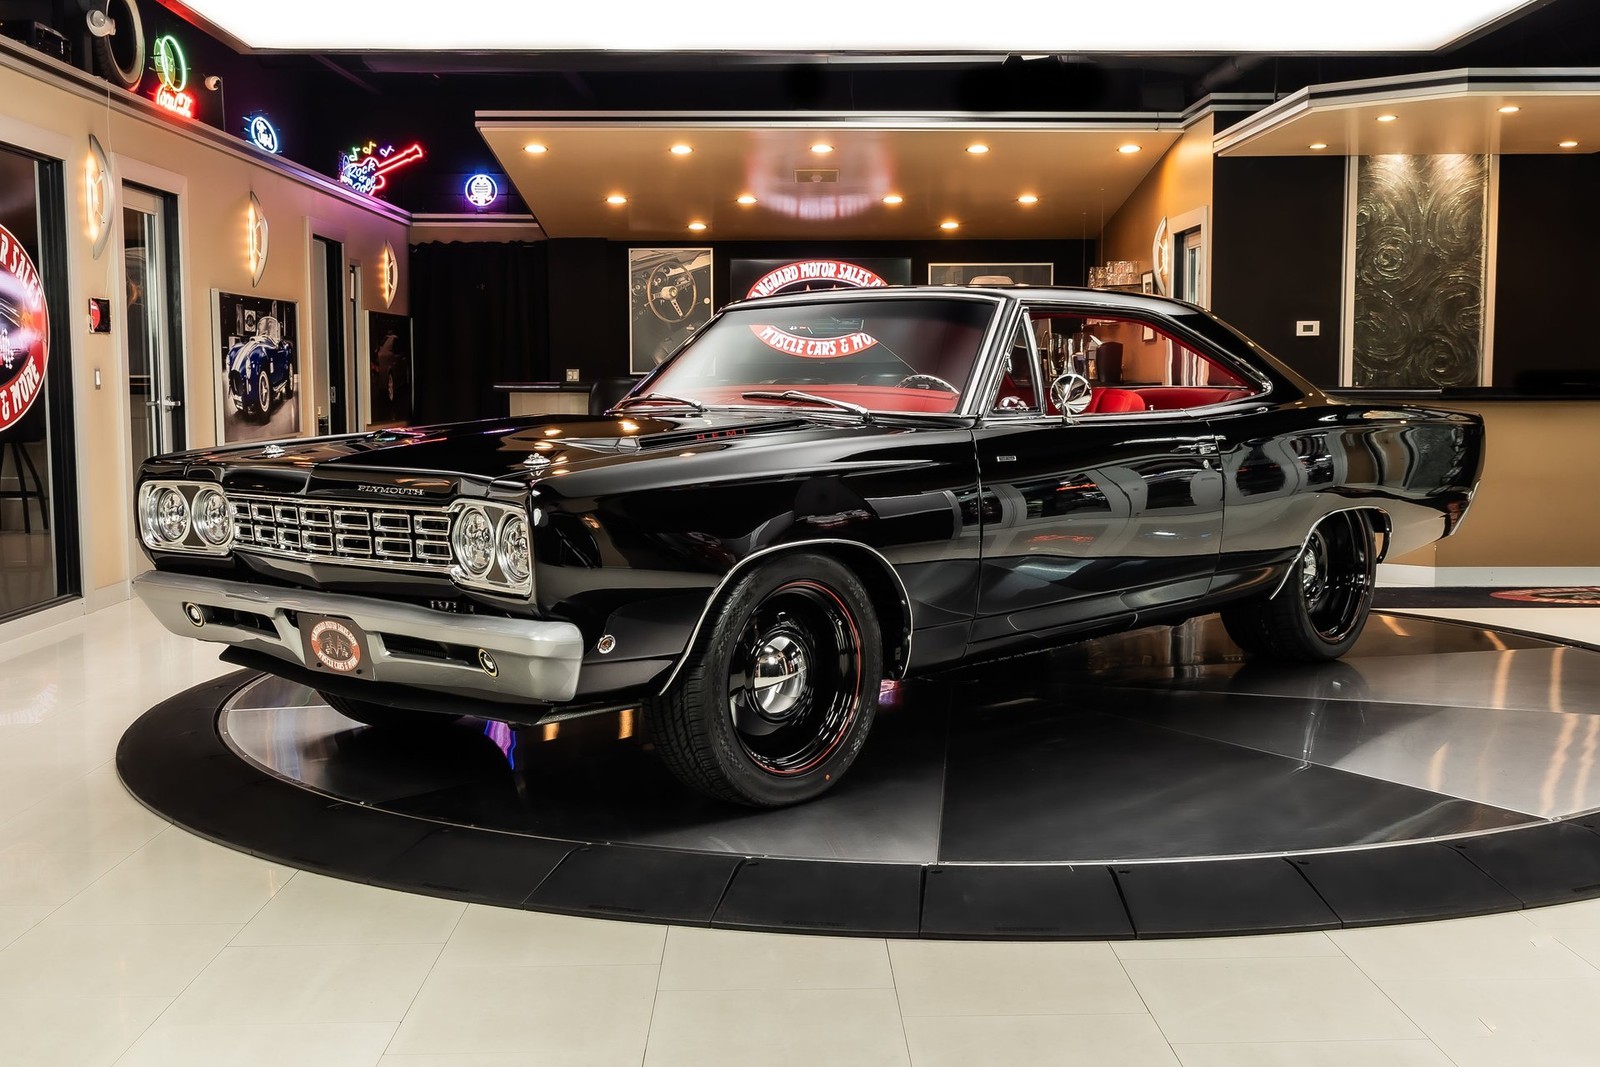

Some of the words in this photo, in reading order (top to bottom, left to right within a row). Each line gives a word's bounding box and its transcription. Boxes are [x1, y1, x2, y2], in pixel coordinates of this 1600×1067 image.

[349, 158, 376, 178] Rock
[750, 264, 799, 299] ANGUARD
[799, 262, 836, 278] MOTOR
[759, 326, 804, 354] MUSCLE
[807, 340, 837, 356] CARS
[840, 339, 850, 352] &
[851, 332, 878, 351] MO
[0, 389, 10, 421] &
[9, 355, 40, 414] MORE
[696, 427, 747, 441] HEMI
[357, 484, 425, 496] PLYMOUTH
